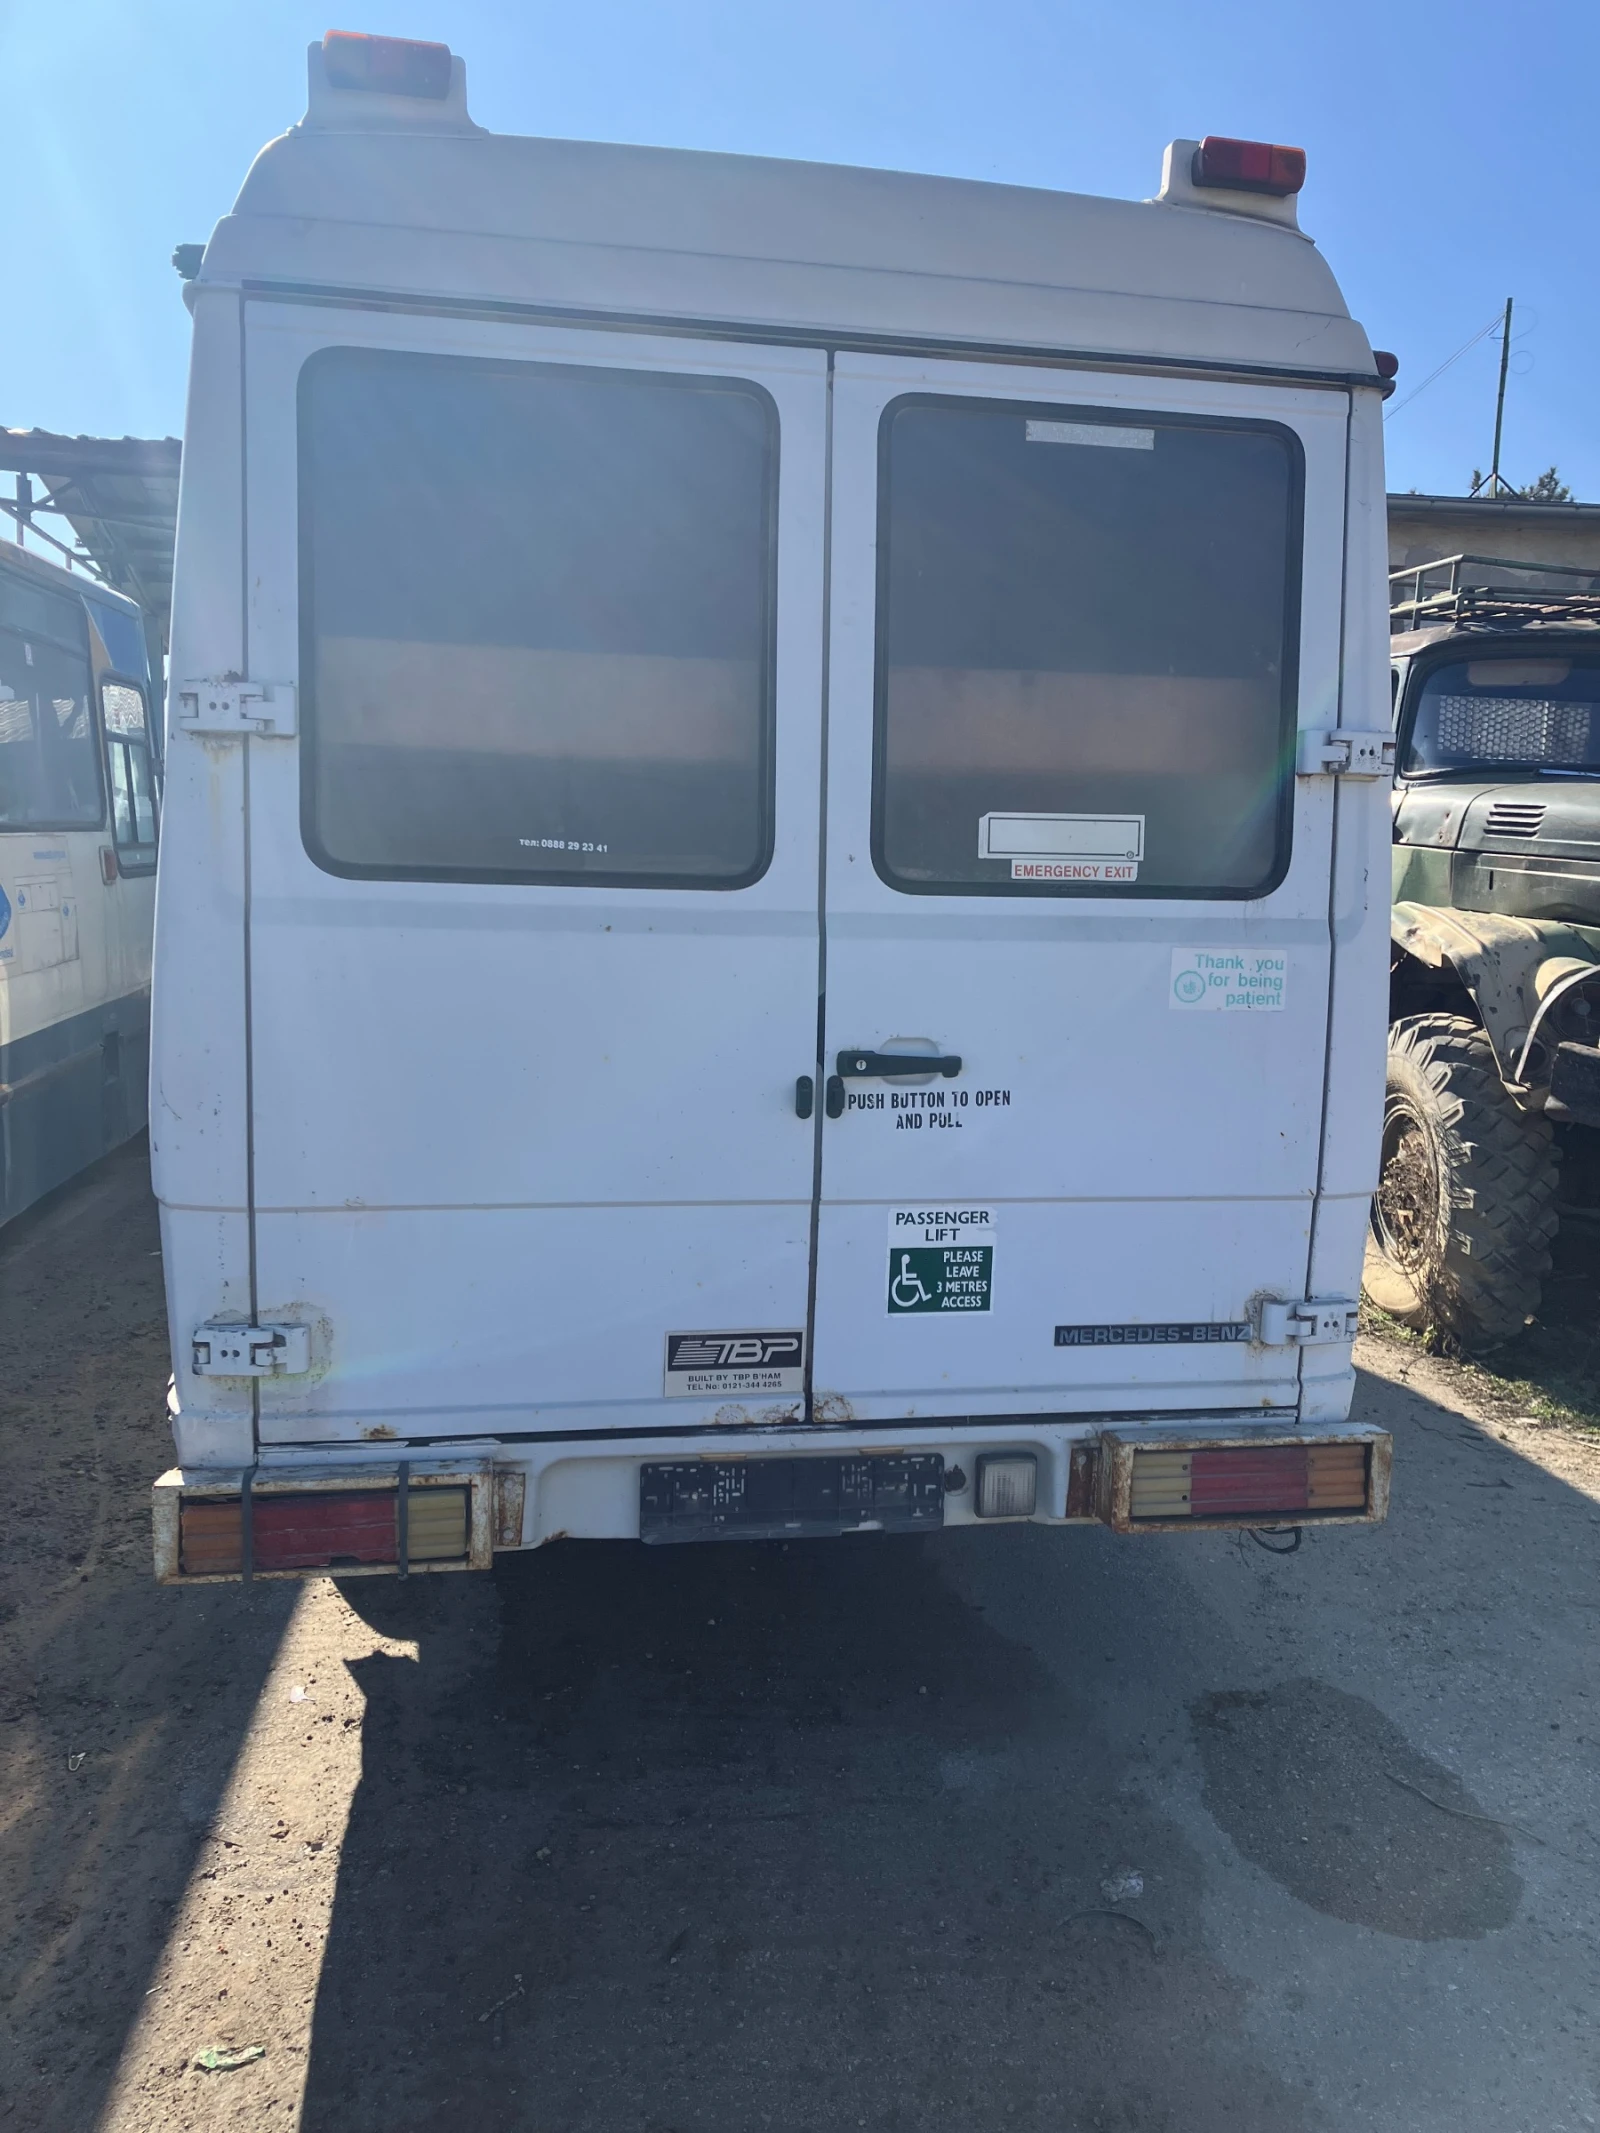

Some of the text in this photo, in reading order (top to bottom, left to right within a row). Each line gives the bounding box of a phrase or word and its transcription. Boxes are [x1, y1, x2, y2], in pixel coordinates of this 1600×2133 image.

[519, 838, 539, 847] тел:
[568, 841, 580, 850] 29
[582, 843, 594, 852] 23
[596, 844, 608, 853] 41
[1014, 864, 1134, 879] EMERGENCY EXIT
[1195, 953, 1284, 973] Thank you
[1208, 972, 1283, 991] for being
[1225, 991, 1282, 1007] patient
[848, 1090, 1011, 1110] PUSH BUTTON TO OPEN
[896, 1113, 923, 1129] AND
[895, 1211, 989, 1225] PASSENGER
[925, 1228, 960, 1241] LIFT
[943, 1251, 983, 1262] PLEASE
[946, 1266, 979, 1277] LEAVE
[936, 1280, 988, 1293] 3 METRES
[941, 1296, 982, 1308] ACCESS
[1059, 1326, 1252, 1344] MERCEDES-BENZ
[704, 1338, 799, 1364] TBP
[688, 1374, 714, 1382] BUILT
[732, 1373, 750, 1381] TBP
[752, 1372, 781, 1380] B'HAM
[686, 1383, 703, 1391] TEL
[705, 1382, 720, 1390] No:
[722, 1381, 760, 1389] 0121-344
